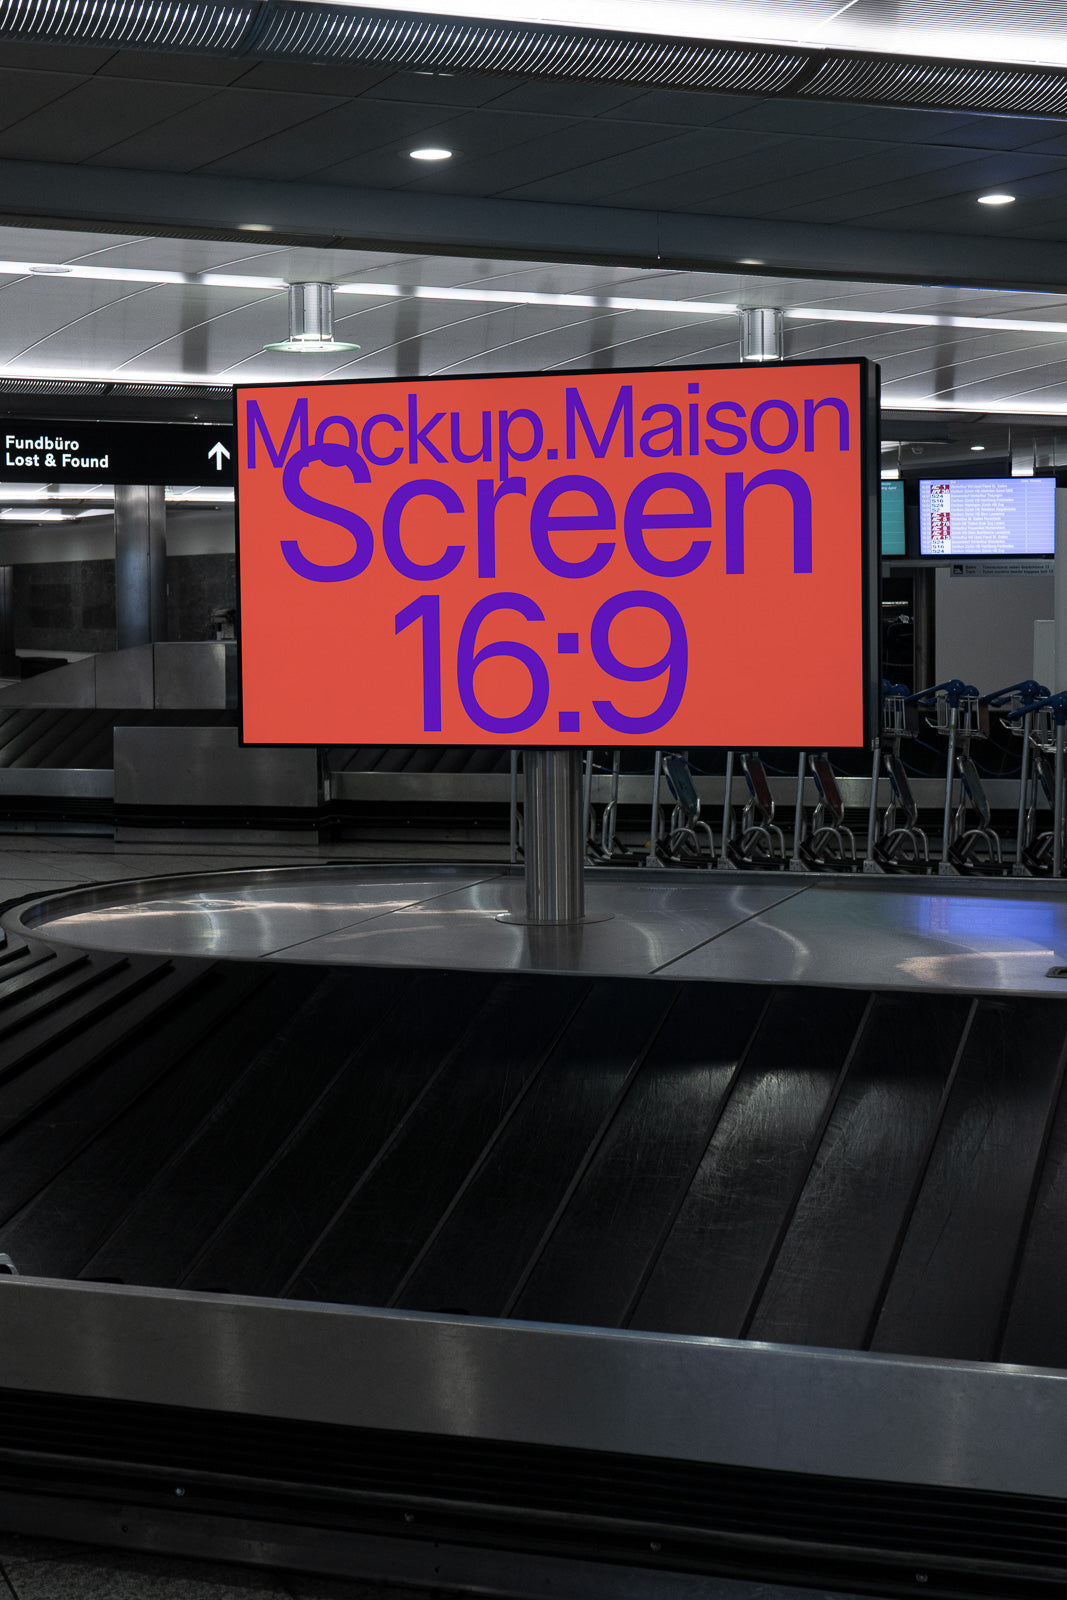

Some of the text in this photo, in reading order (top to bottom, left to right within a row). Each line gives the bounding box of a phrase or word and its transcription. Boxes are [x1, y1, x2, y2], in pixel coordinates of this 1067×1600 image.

[5, 434, 80, 451] Fundbüro
[6, 452, 109, 469] Lost & Found
[246, 382, 850, 482] Mockup.Maison
[279, 443, 813, 583] Screen
[394, 589, 689, 737] 16:9
